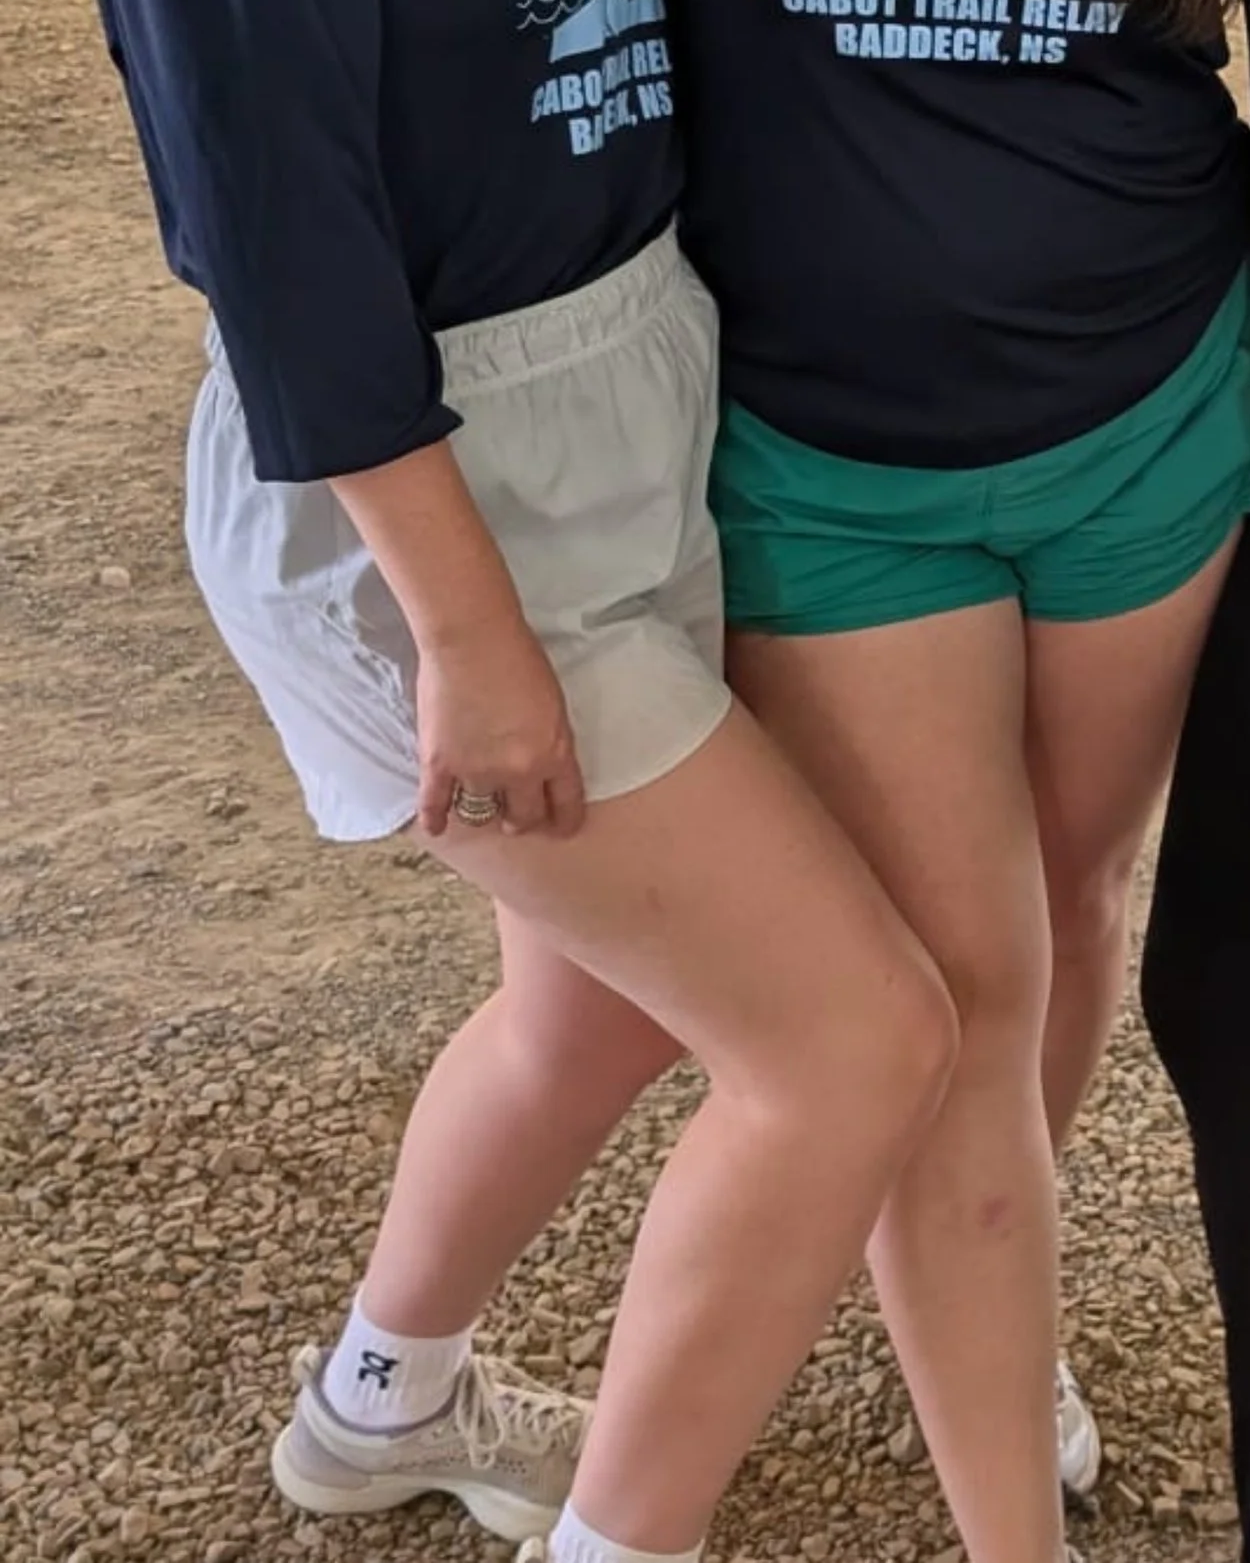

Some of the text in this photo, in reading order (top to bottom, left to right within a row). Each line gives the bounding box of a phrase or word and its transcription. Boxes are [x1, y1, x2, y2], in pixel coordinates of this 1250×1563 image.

[835, 23, 1068, 65] BADDECK, NS
[637, 80, 674, 120] NS
